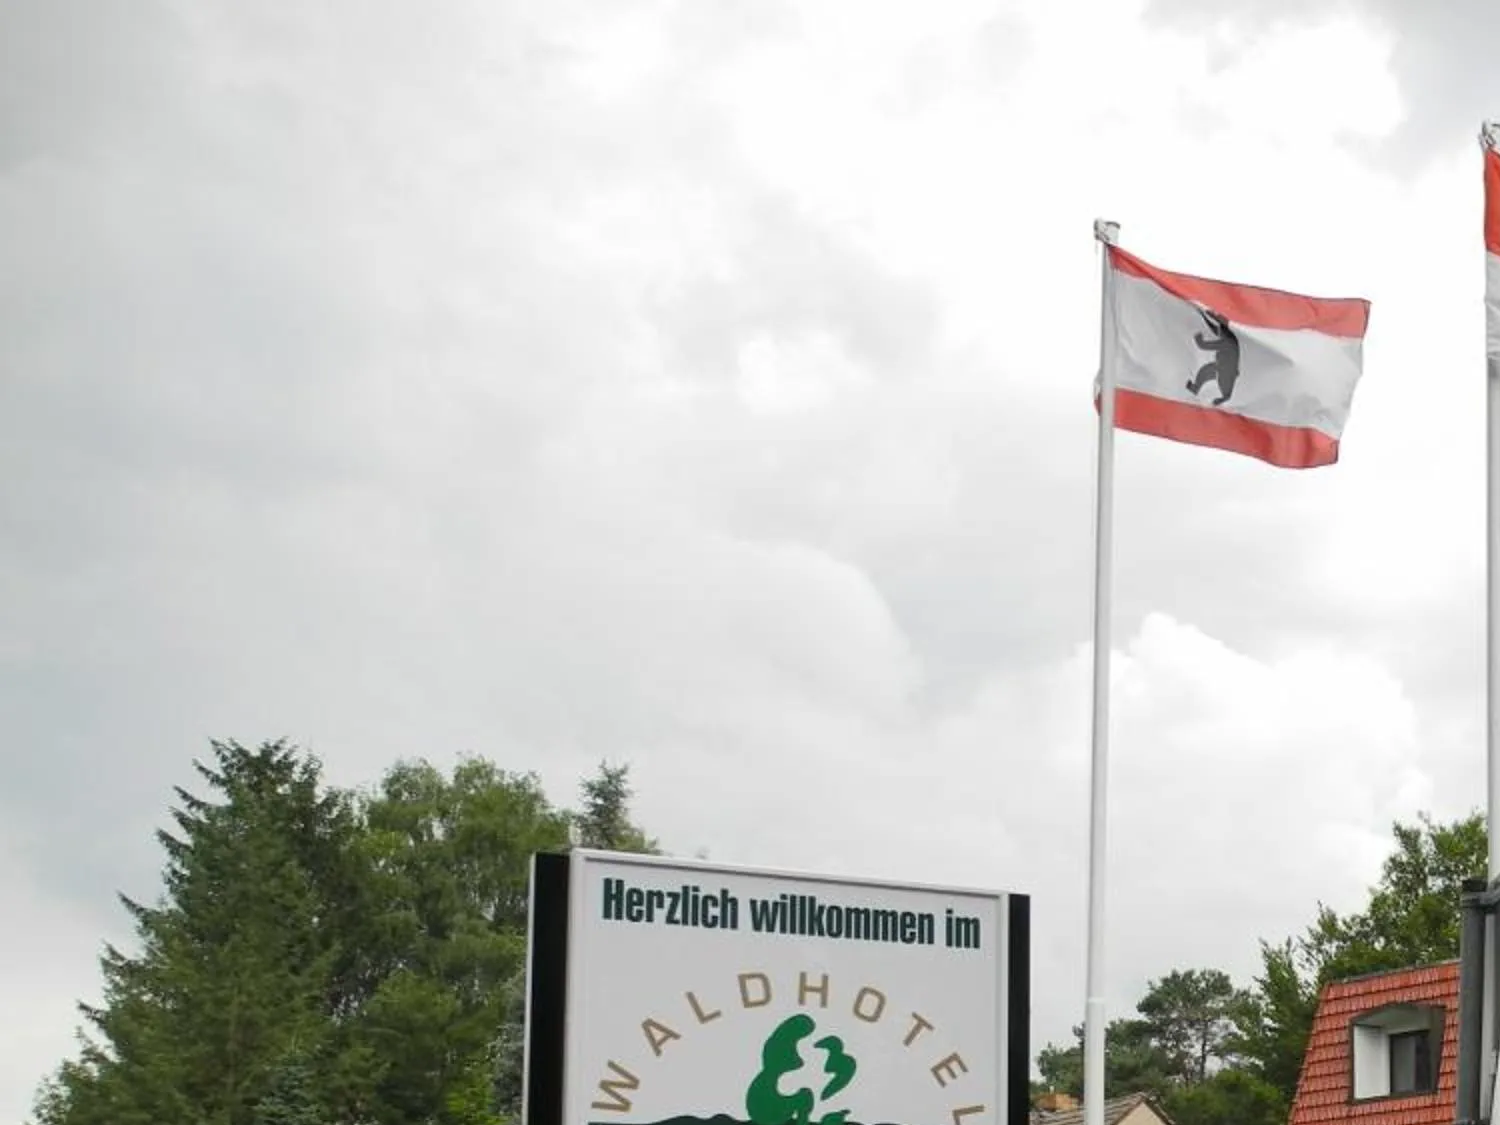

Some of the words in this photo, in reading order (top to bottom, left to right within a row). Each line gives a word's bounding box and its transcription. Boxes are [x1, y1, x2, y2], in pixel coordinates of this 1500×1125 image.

[602, 877, 739, 930] Herzlich
[750, 894, 935, 945] willkommen
[945, 909, 981, 949] im
